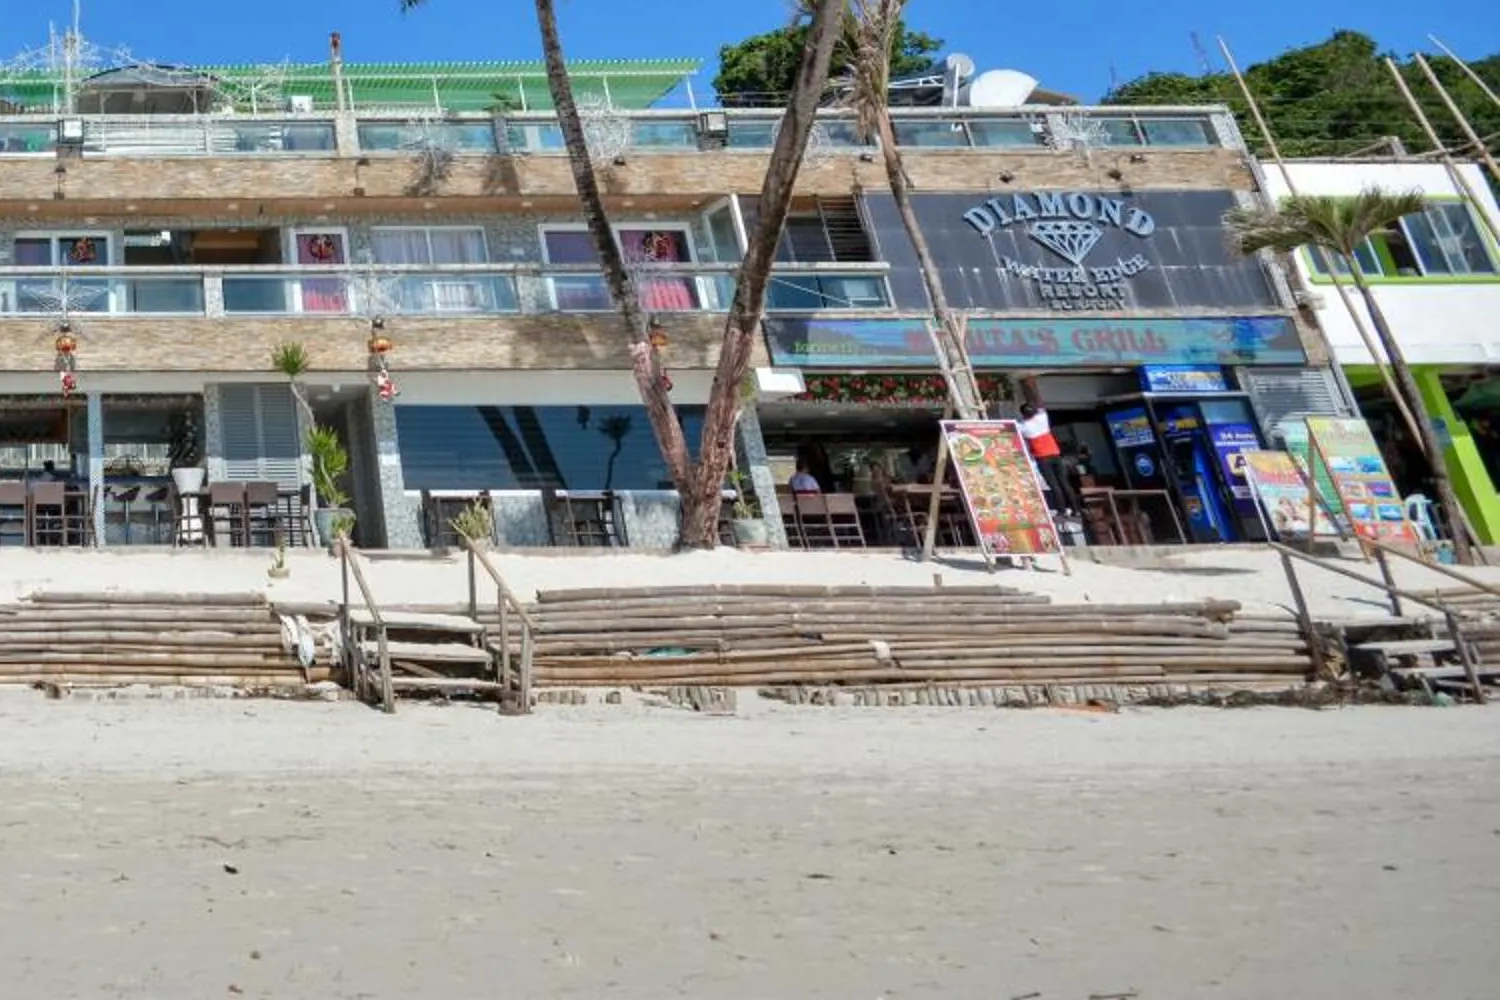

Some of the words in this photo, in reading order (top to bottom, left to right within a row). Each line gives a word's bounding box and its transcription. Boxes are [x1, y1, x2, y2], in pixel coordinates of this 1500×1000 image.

[963, 190, 1156, 237] DIAMOND
[1090, 253, 1150, 282] EDGE
[1039, 281, 1126, 299] RESORT
